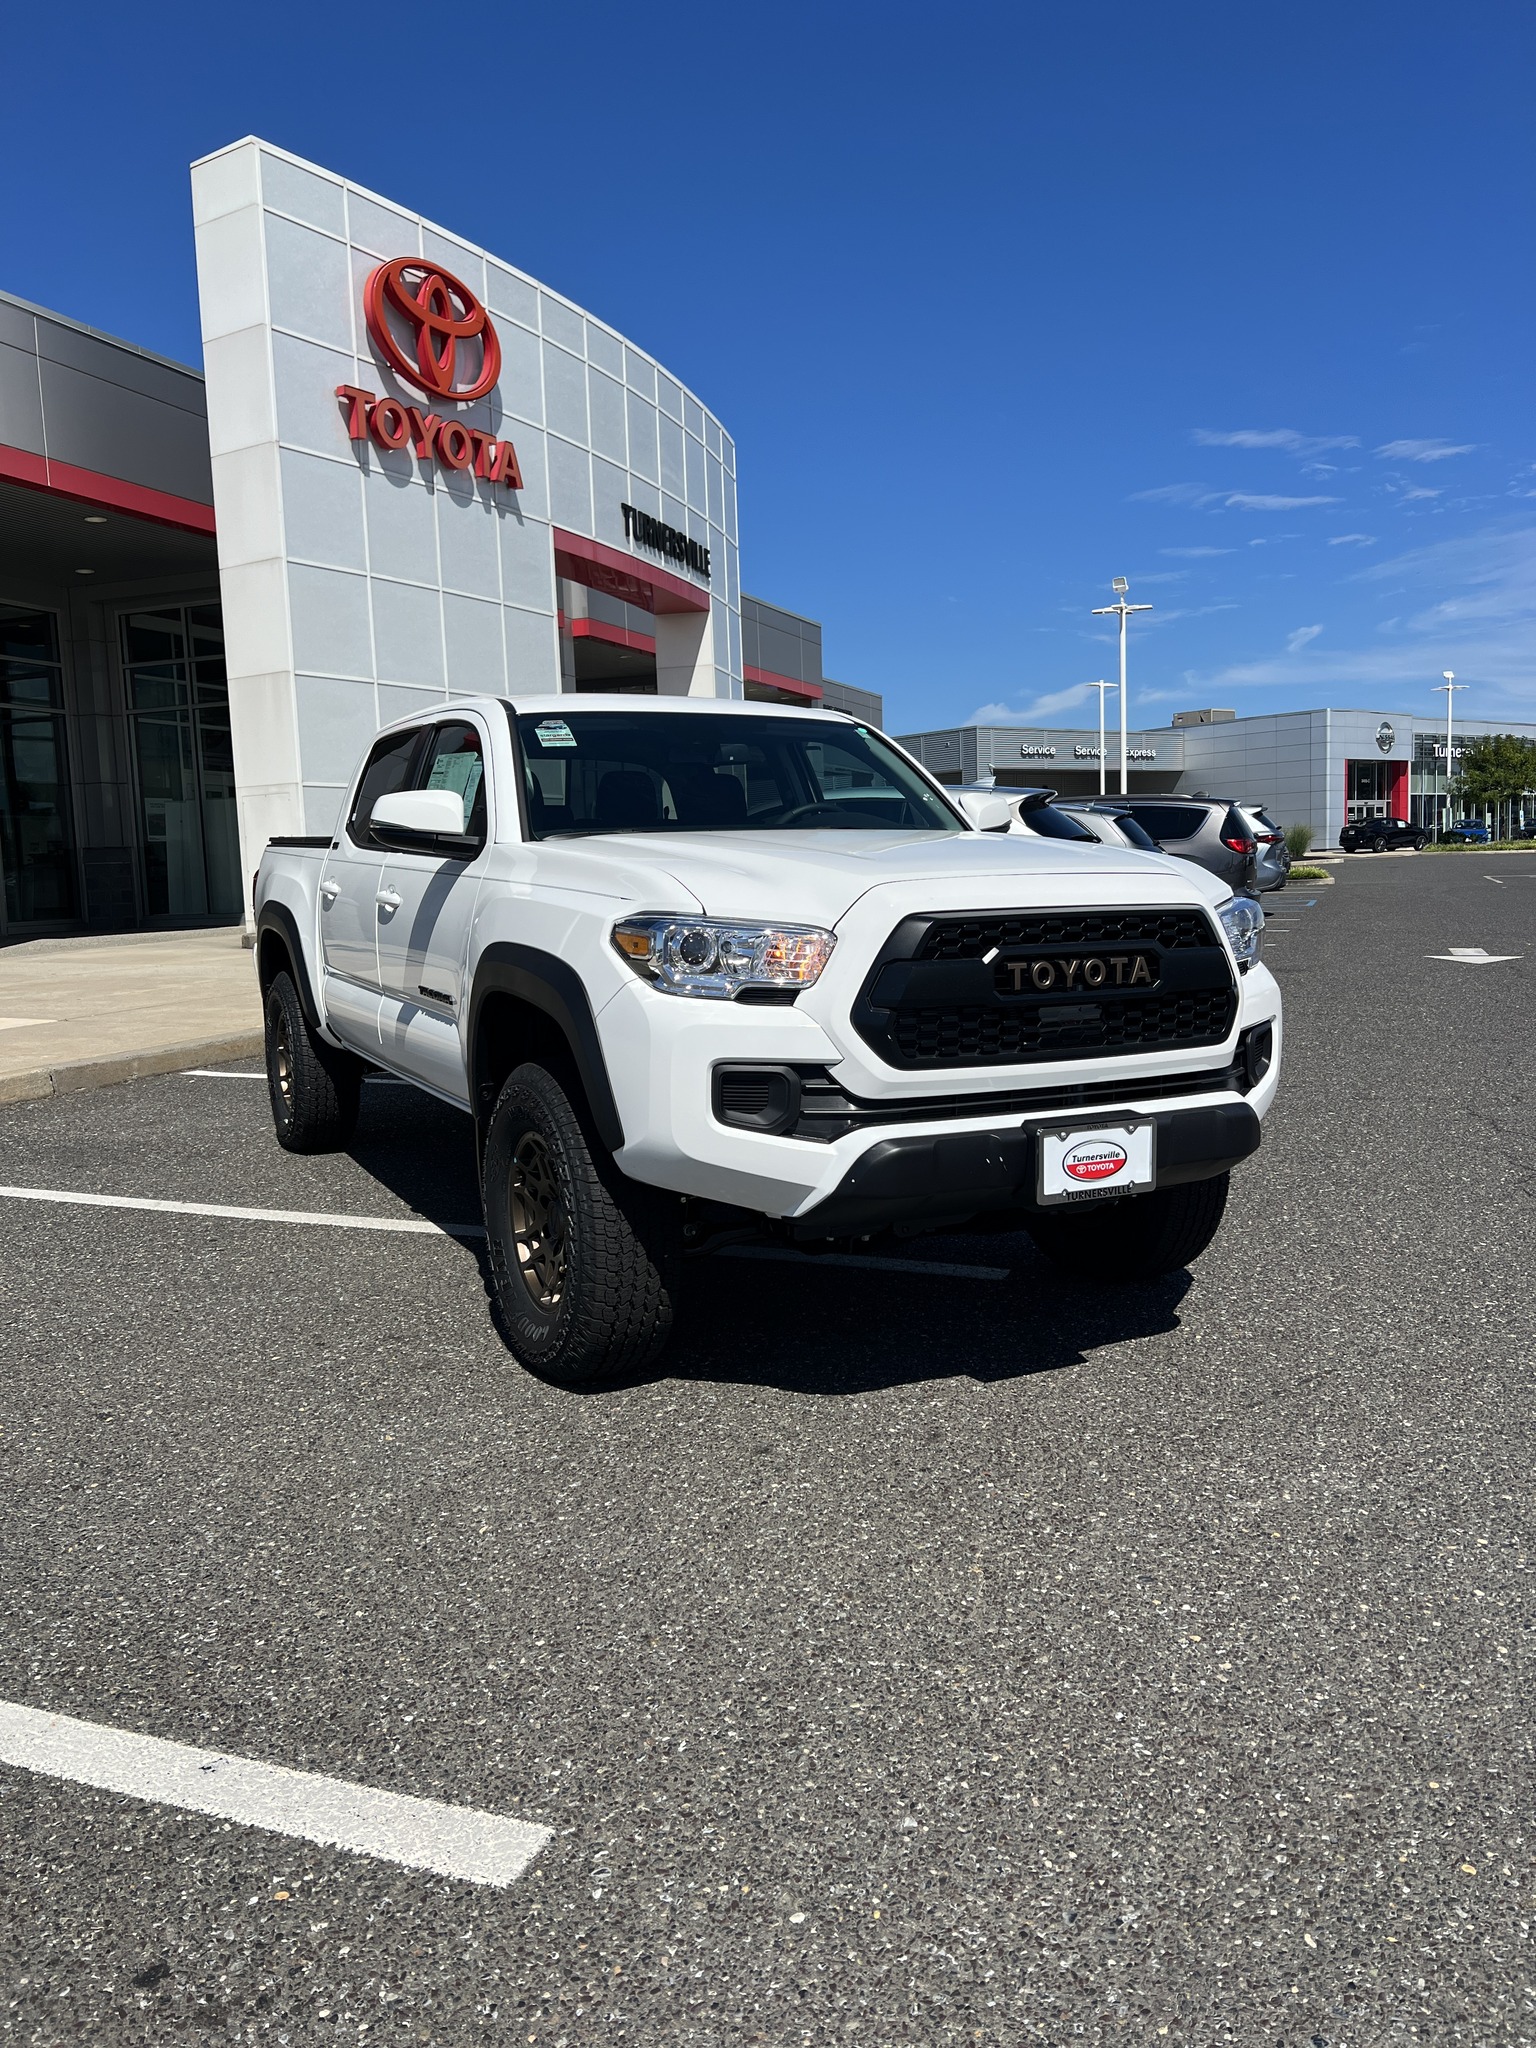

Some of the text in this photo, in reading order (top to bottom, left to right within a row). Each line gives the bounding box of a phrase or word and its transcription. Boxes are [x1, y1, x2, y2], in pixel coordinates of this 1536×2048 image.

[337, 385, 524, 489] TOYOTA
[620, 502, 711, 579] TURNERSVILLE
[1021, 744, 1056, 756] Service
[1074, 745, 1157, 759] Service Express
[1006, 955, 1152, 991] TOYOTA
[1072, 1150, 1121, 1163] Turnersville
[1087, 1162, 1115, 1172] TOYOTA
[1066, 1185, 1132, 1202] TURNERSVILLE
